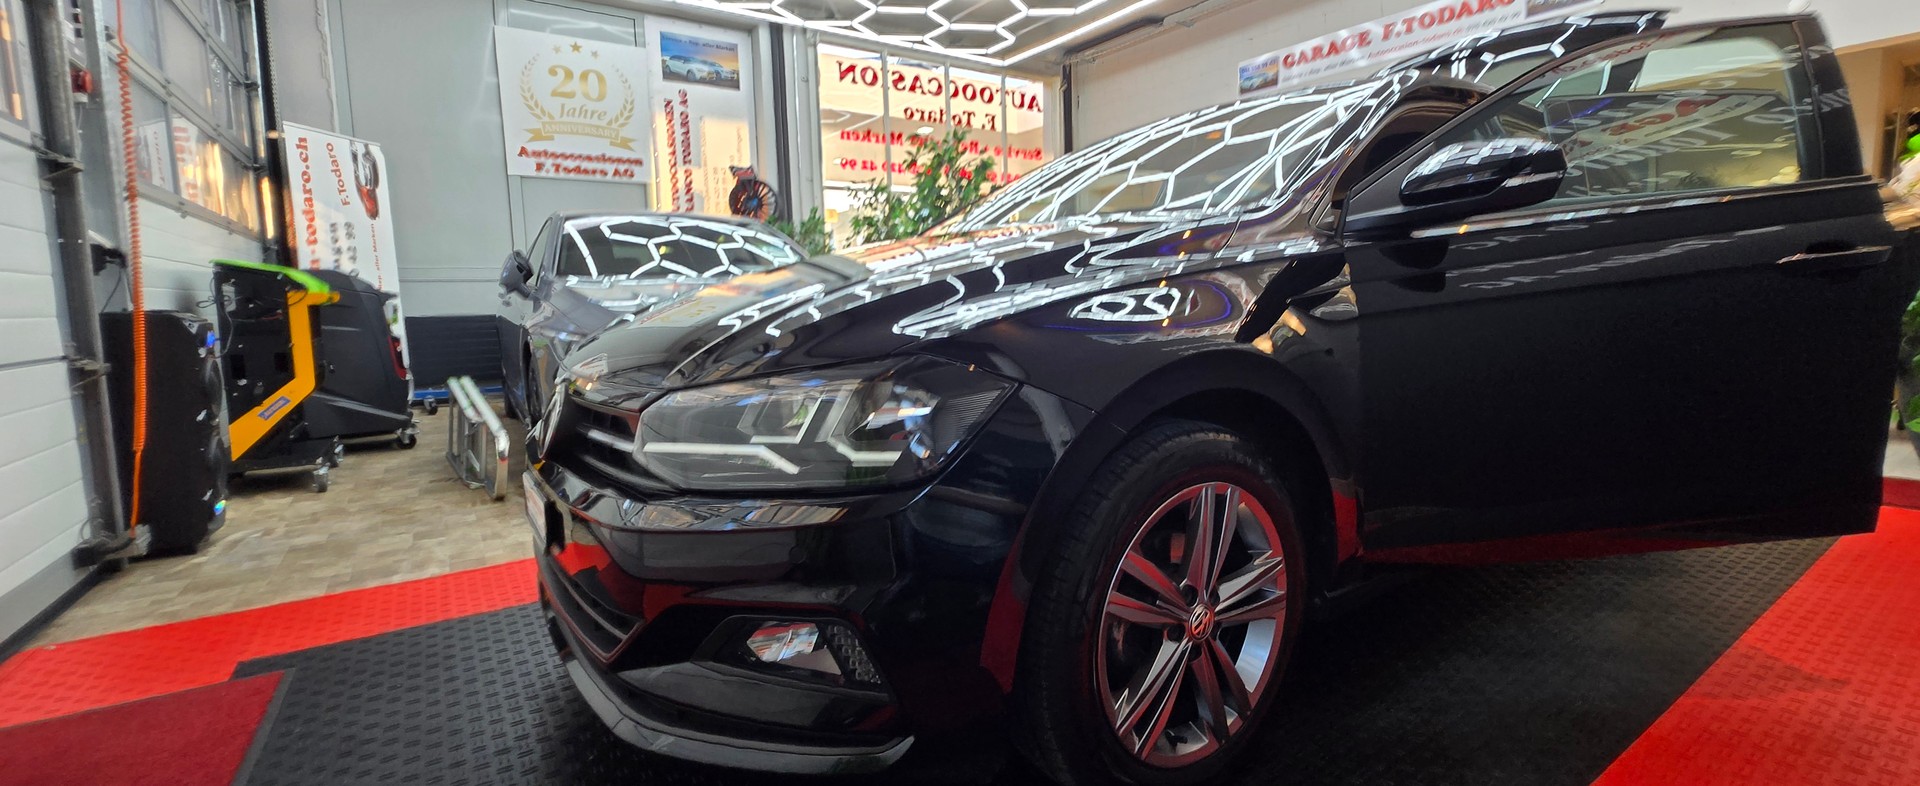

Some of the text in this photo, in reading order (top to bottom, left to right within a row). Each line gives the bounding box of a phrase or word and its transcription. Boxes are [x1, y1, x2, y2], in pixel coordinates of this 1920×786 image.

[1281, 30, 1373, 69] GARAGE
[548, 64, 607, 102] 20
[559, 103, 607, 120] Jahre
[543, 122, 618, 138] ANNIVERSARY
